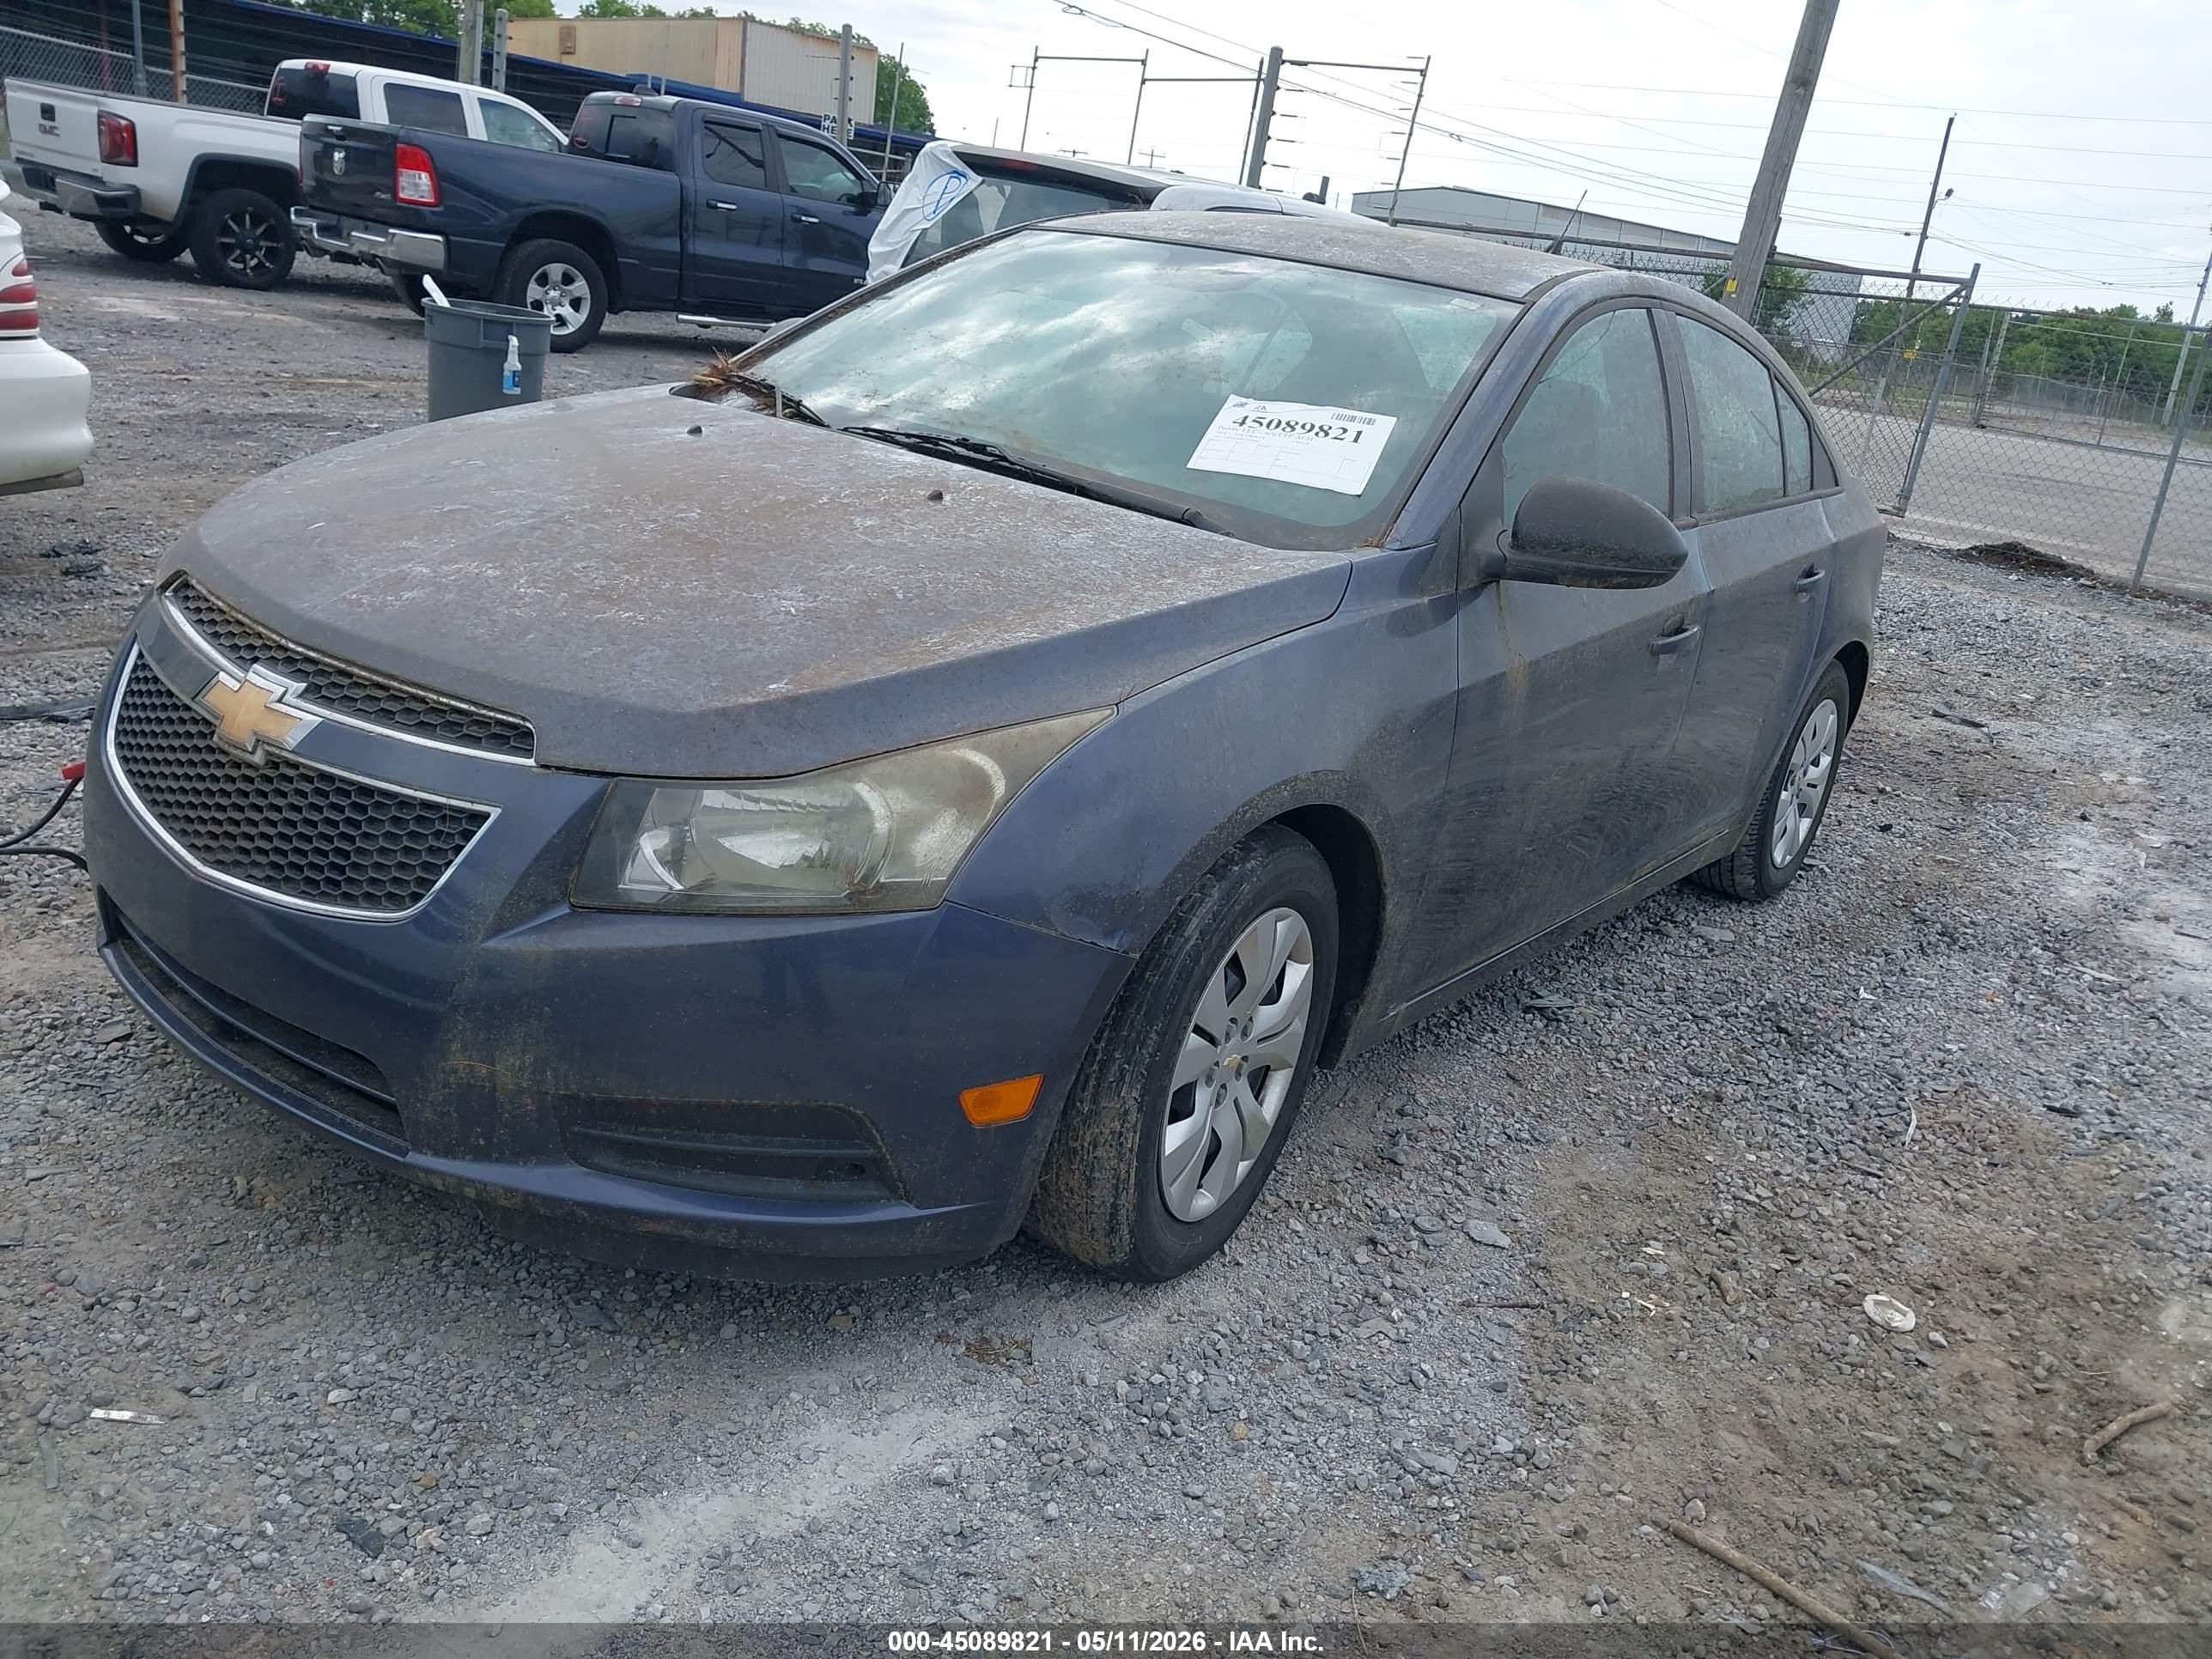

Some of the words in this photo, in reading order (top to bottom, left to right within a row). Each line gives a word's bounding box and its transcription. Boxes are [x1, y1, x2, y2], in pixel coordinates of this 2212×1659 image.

[823, 113, 854, 127] PAK
[823, 125, 853, 138] HEE
[1232, 415, 1364, 444] 45089821
